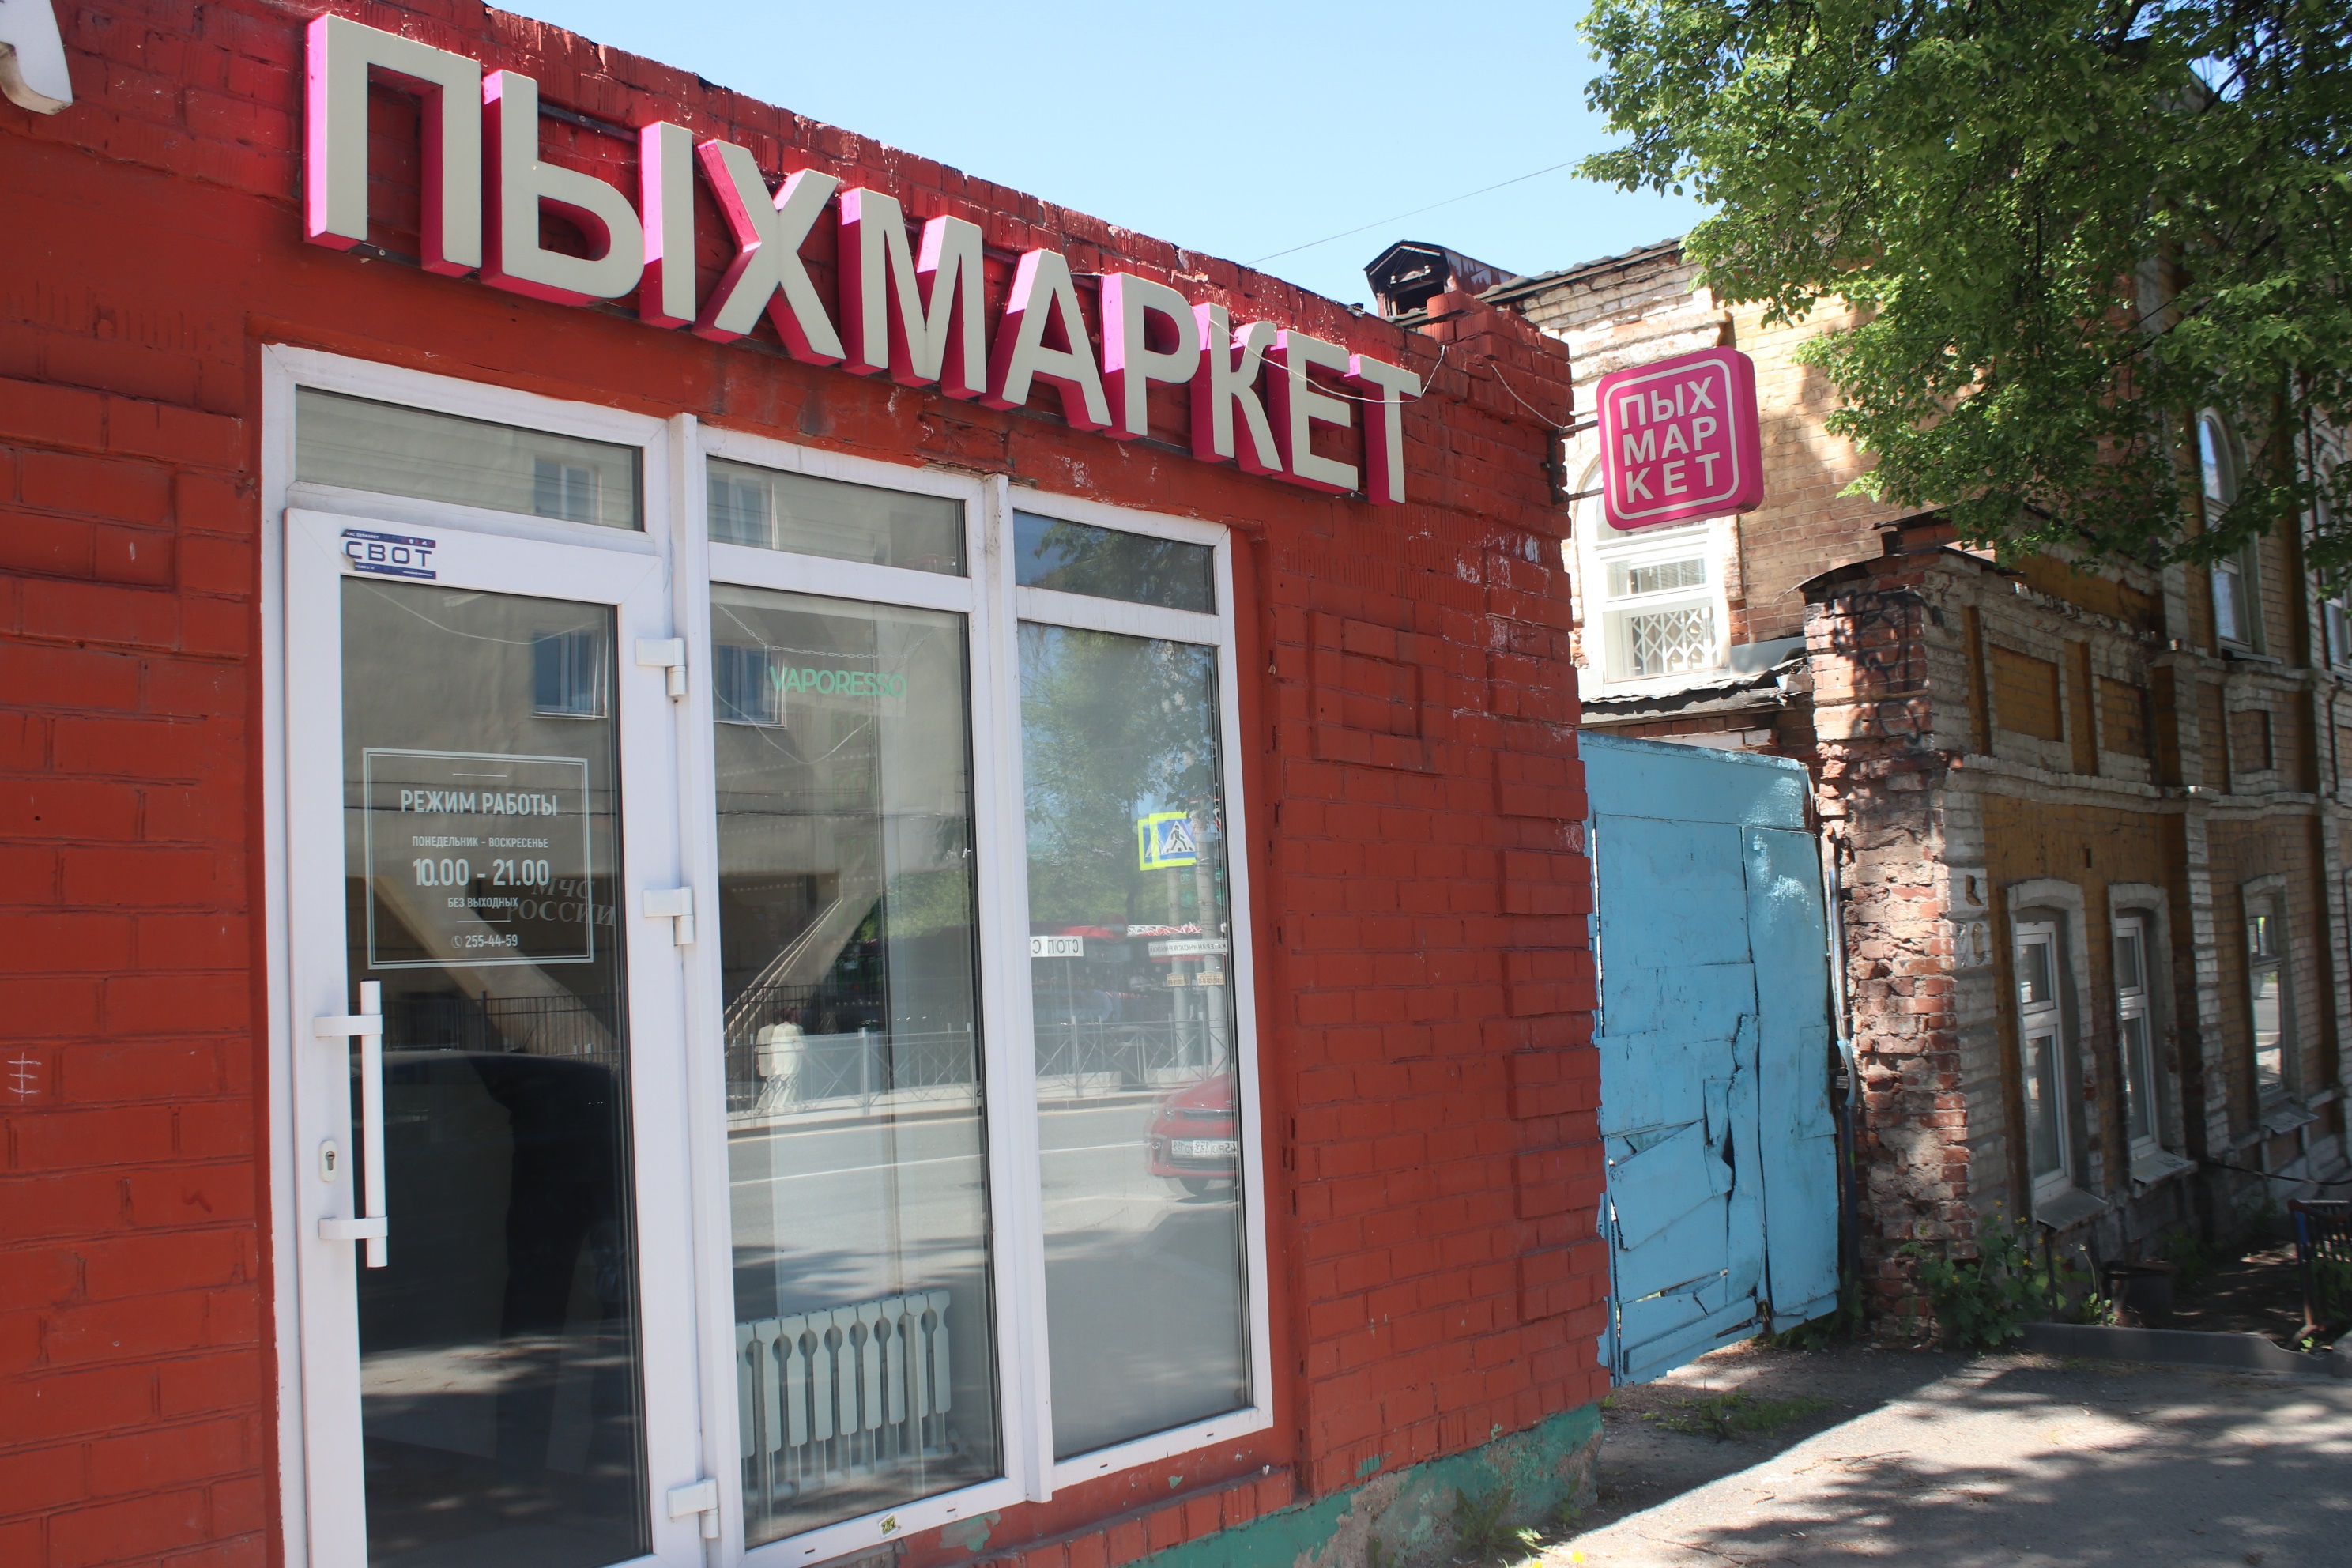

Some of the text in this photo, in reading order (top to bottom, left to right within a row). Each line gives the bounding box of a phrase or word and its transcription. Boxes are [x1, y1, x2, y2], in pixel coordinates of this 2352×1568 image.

[304, 13, 1423, 506] ПЫХМАРКЕТ
[1619, 376, 1717, 430] ПЫХ
[1622, 415, 1717, 466] МАР
[1625, 451, 1721, 503] КЕТ
[345, 541, 432, 567] СВОТ
[769, 666, 906, 697] VAPORESSO
[401, 790, 557, 816] РЕЖИМ РАБОТЫ
[412, 835, 478, 848] ПОНЕДЕЛЬНИК
[488, 837, 548, 848] ВОСКРЕСЕНЬЕ
[413, 858, 469, 886] 10.00
[492, 859, 549, 886] 21.00
[447, 898, 518, 909] БЕЗ ВЫХОДНЫХ
[465, 934, 518, 948] 255-44-59
